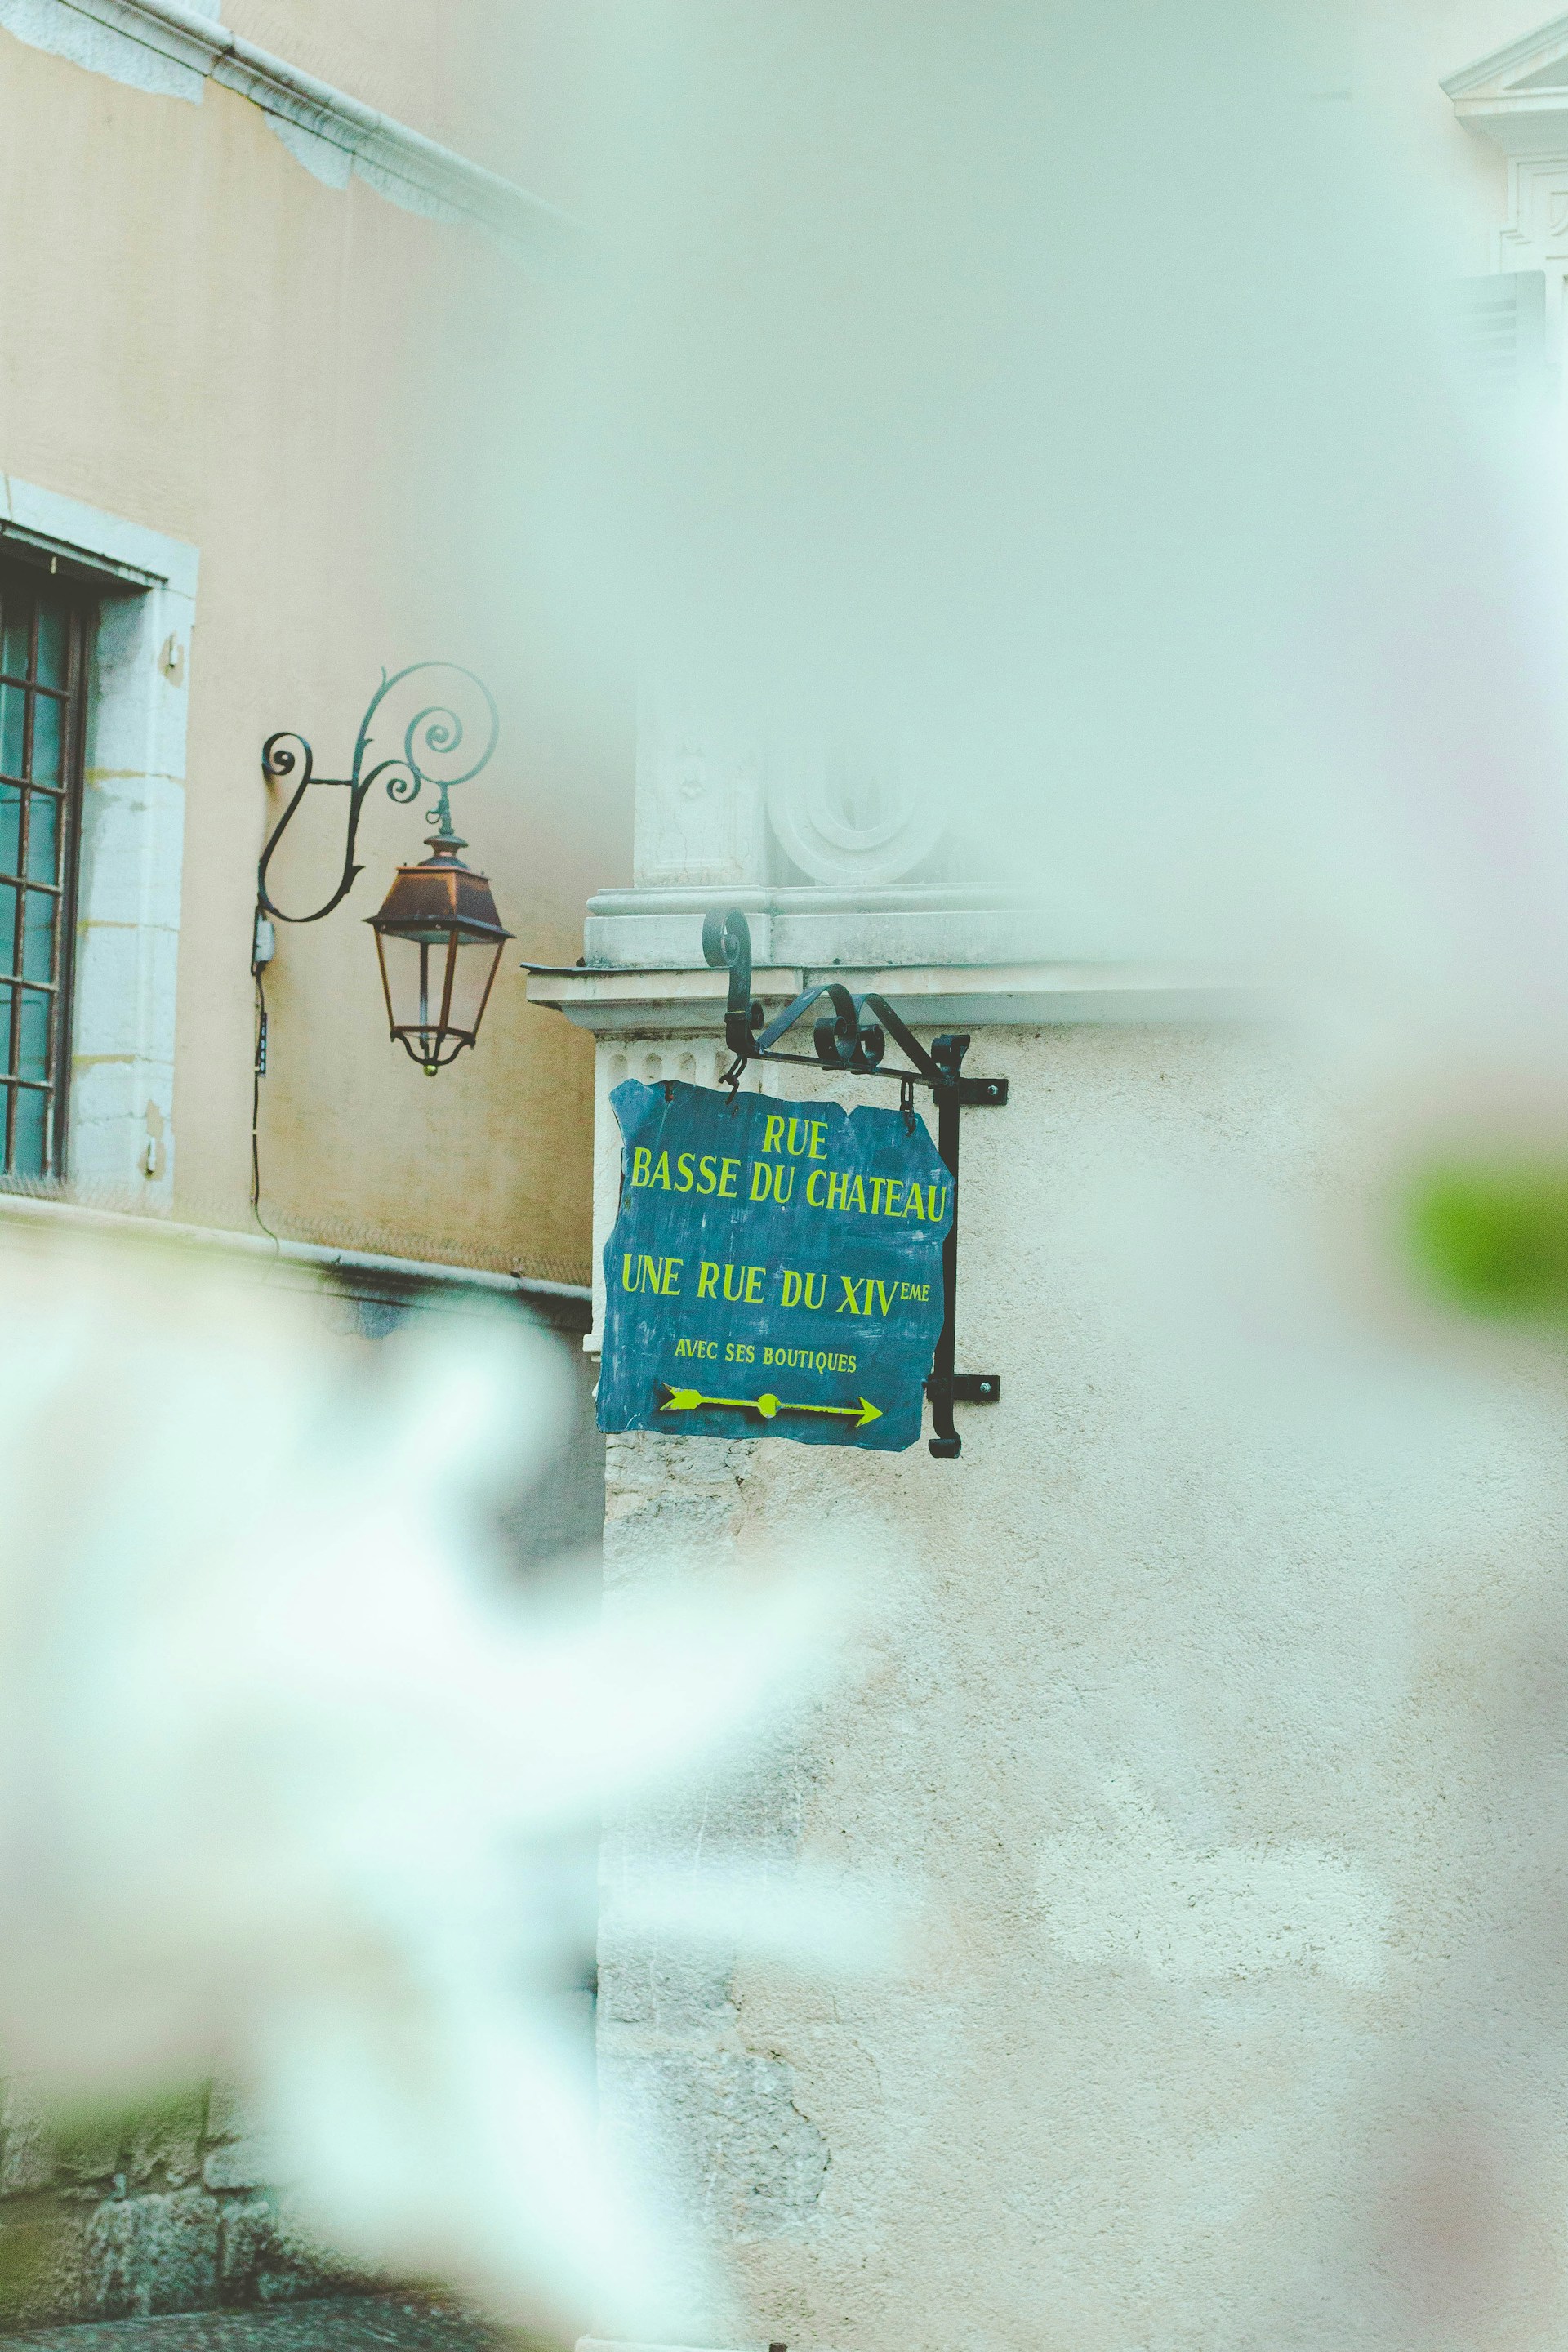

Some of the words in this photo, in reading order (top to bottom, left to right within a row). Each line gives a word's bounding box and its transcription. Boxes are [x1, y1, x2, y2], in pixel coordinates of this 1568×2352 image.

[761, 1114, 829, 1160] RUE
[630, 1147, 742, 1198] BASSE
[749, 1161, 796, 1204] DU
[806, 1169, 947, 1223] CHATEAU
[621, 1253, 684, 1296] UNE
[697, 1261, 767, 1304] RUE
[780, 1269, 828, 1310] DU
[674, 1338, 718, 1360] AVEC
[724, 1343, 755, 1364] SES
[762, 1346, 857, 1374] BOUTIQUES
